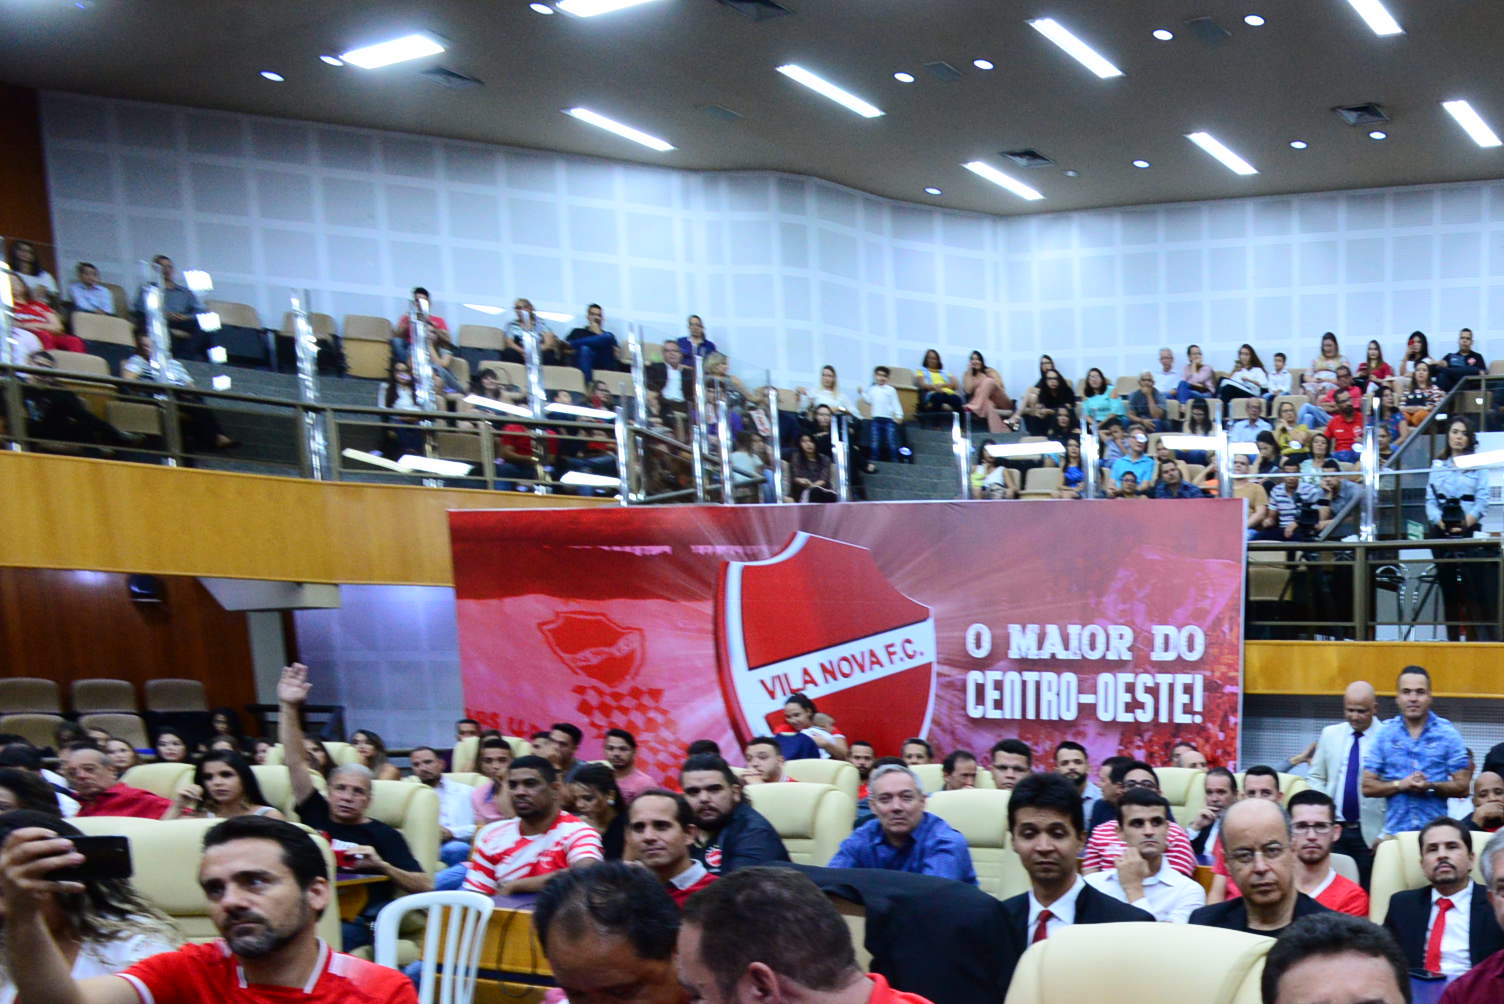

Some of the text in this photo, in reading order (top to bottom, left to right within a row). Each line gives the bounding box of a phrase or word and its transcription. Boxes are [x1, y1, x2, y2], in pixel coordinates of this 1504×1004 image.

[965, 623, 1206, 661] O MAIOR DO
[759, 638, 925, 701] VILA NOVA F.C.
[965, 670, 1205, 724] CENTRO-OESTE!
